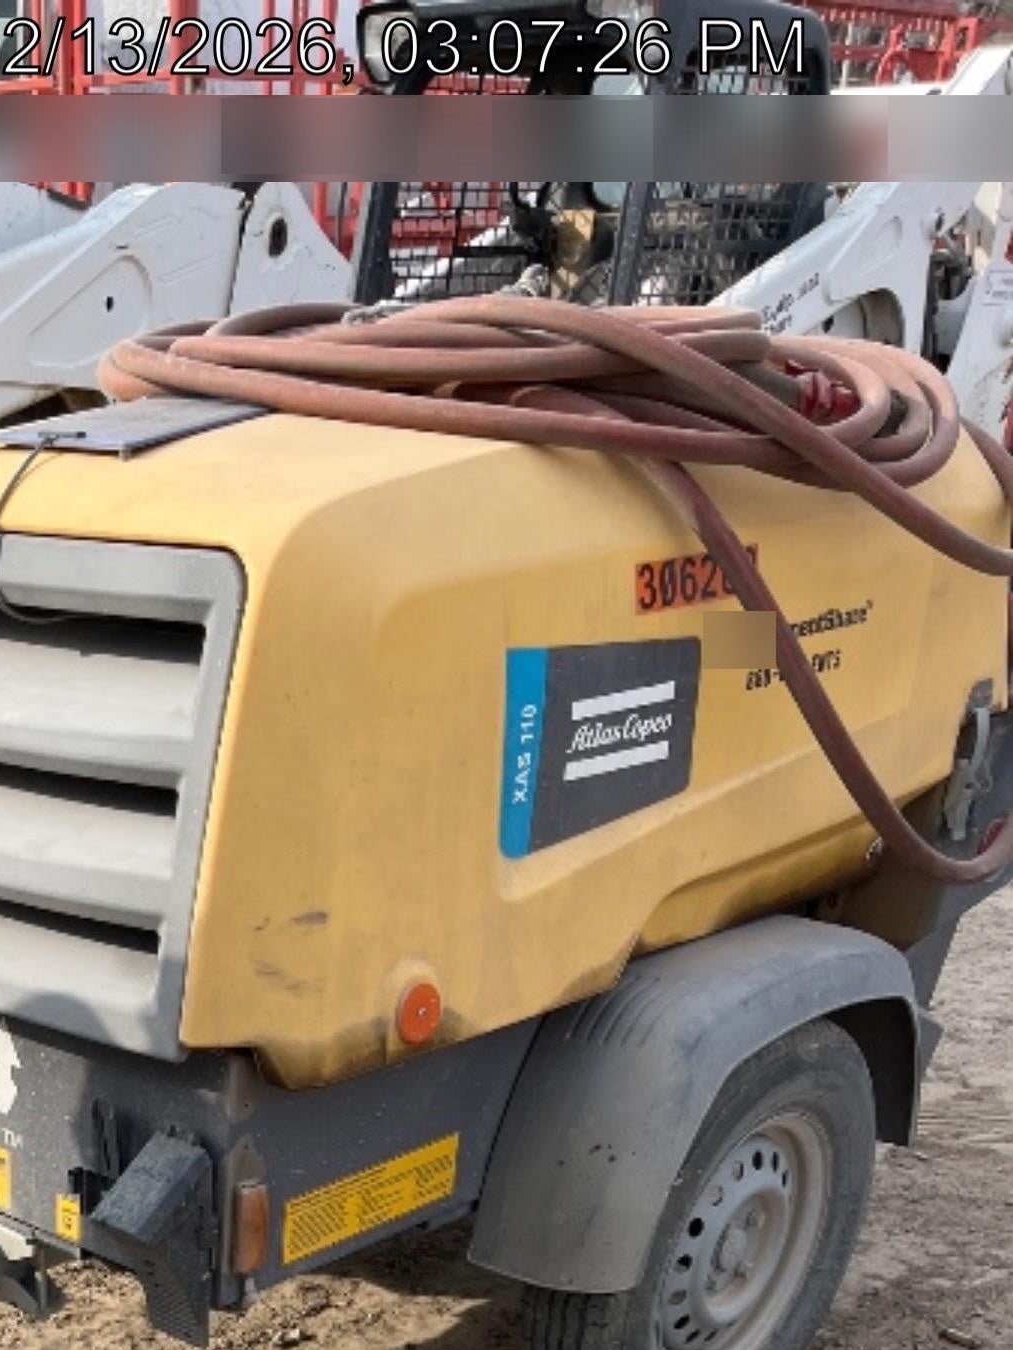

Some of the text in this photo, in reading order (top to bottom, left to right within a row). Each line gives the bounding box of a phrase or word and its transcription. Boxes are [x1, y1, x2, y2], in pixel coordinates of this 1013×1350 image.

[639, 545, 756, 609] 3062
[512, 704, 537, 805] XAS 110
[566, 713, 672, 753] Atlas Copco
